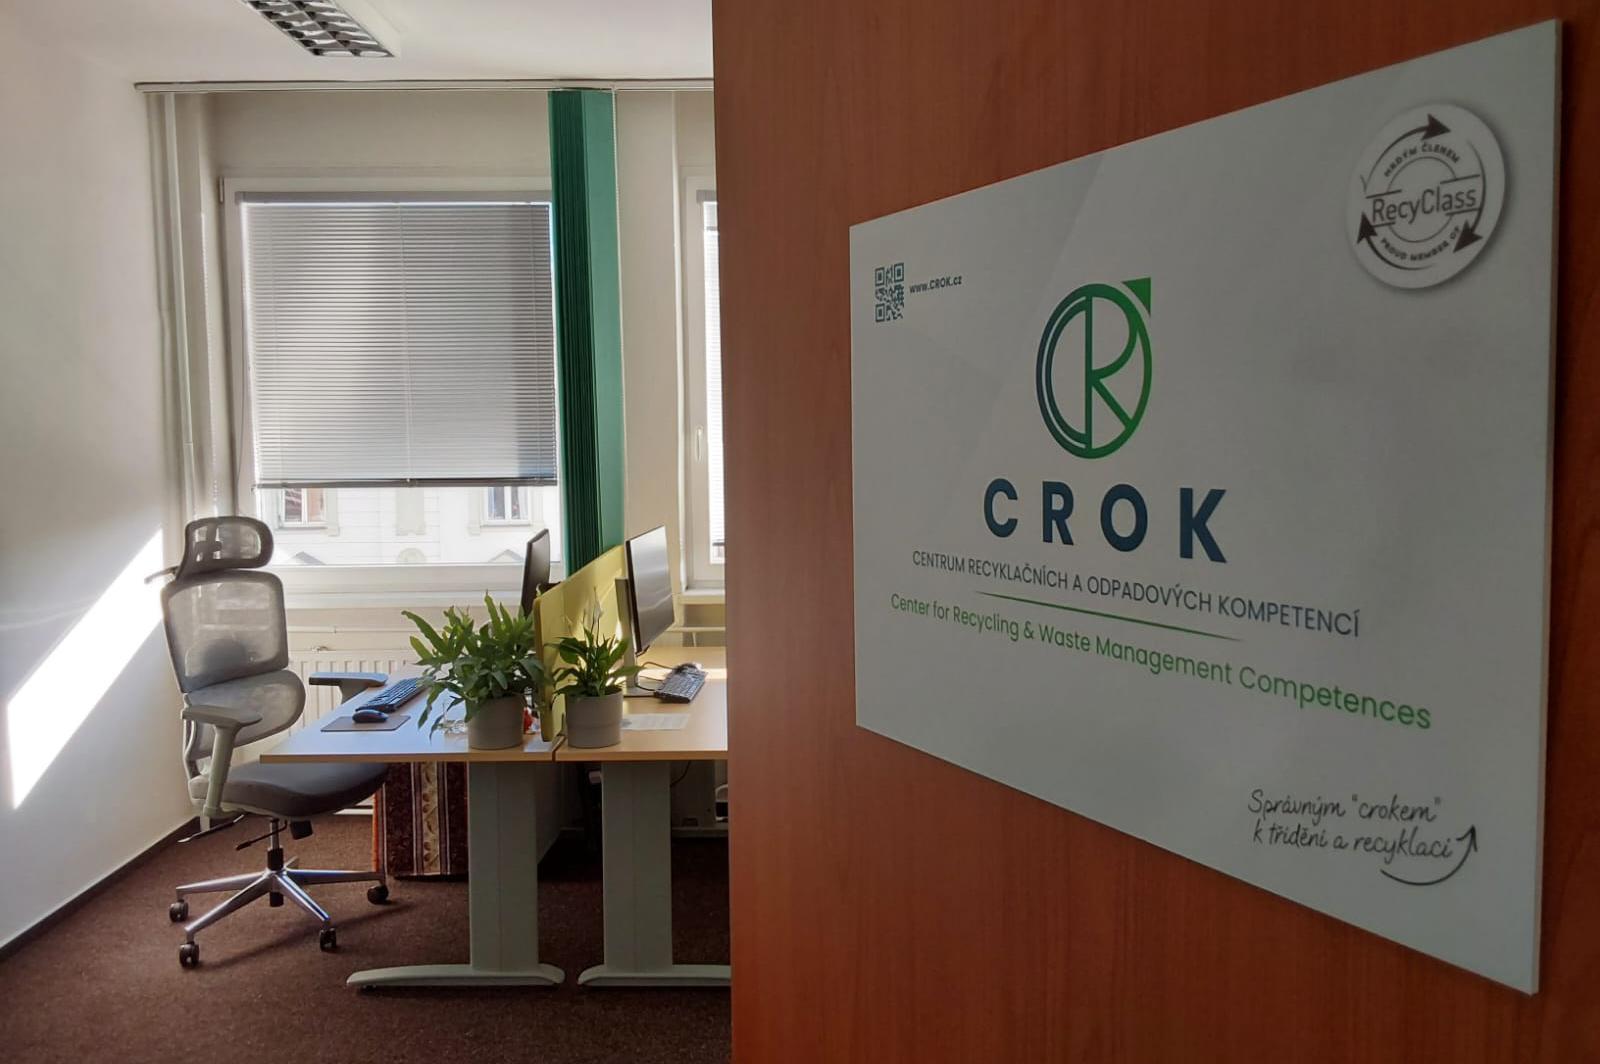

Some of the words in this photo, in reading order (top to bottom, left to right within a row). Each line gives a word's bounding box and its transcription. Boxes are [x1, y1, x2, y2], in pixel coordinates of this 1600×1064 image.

[1372, 186, 1477, 225] RecyClass
[1410, 240, 1449, 261] MEMBER
[909, 275, 963, 293] www.CROK.cz
[984, 478, 1227, 563] CROK
[912, 550, 965, 573] CENTRUM
[968, 558, 1068, 590] RECYKLAČNÍCH
[1072, 574, 1083, 592] A
[1087, 575, 1212, 613] ODPADOVÝCH
[1218, 595, 1360, 637] KOMPETENCÍ
[891, 593, 930, 616] Center
[933, 600, 950, 621] for
[953, 605, 1020, 642] Recycling
[1023, 621, 1035, 640] &
[1039, 623, 1090, 652] Waste
[1096, 635, 1232, 685] Management
[1239, 666, 1431, 730] Competences
[1248, 788, 1346, 826] Správným
[1352, 794, 1441, 823] "crokem"
[1253, 818, 1264, 845] k
[1333, 834, 1349, 850] a
[1353, 825, 1454, 865] recyklaci
